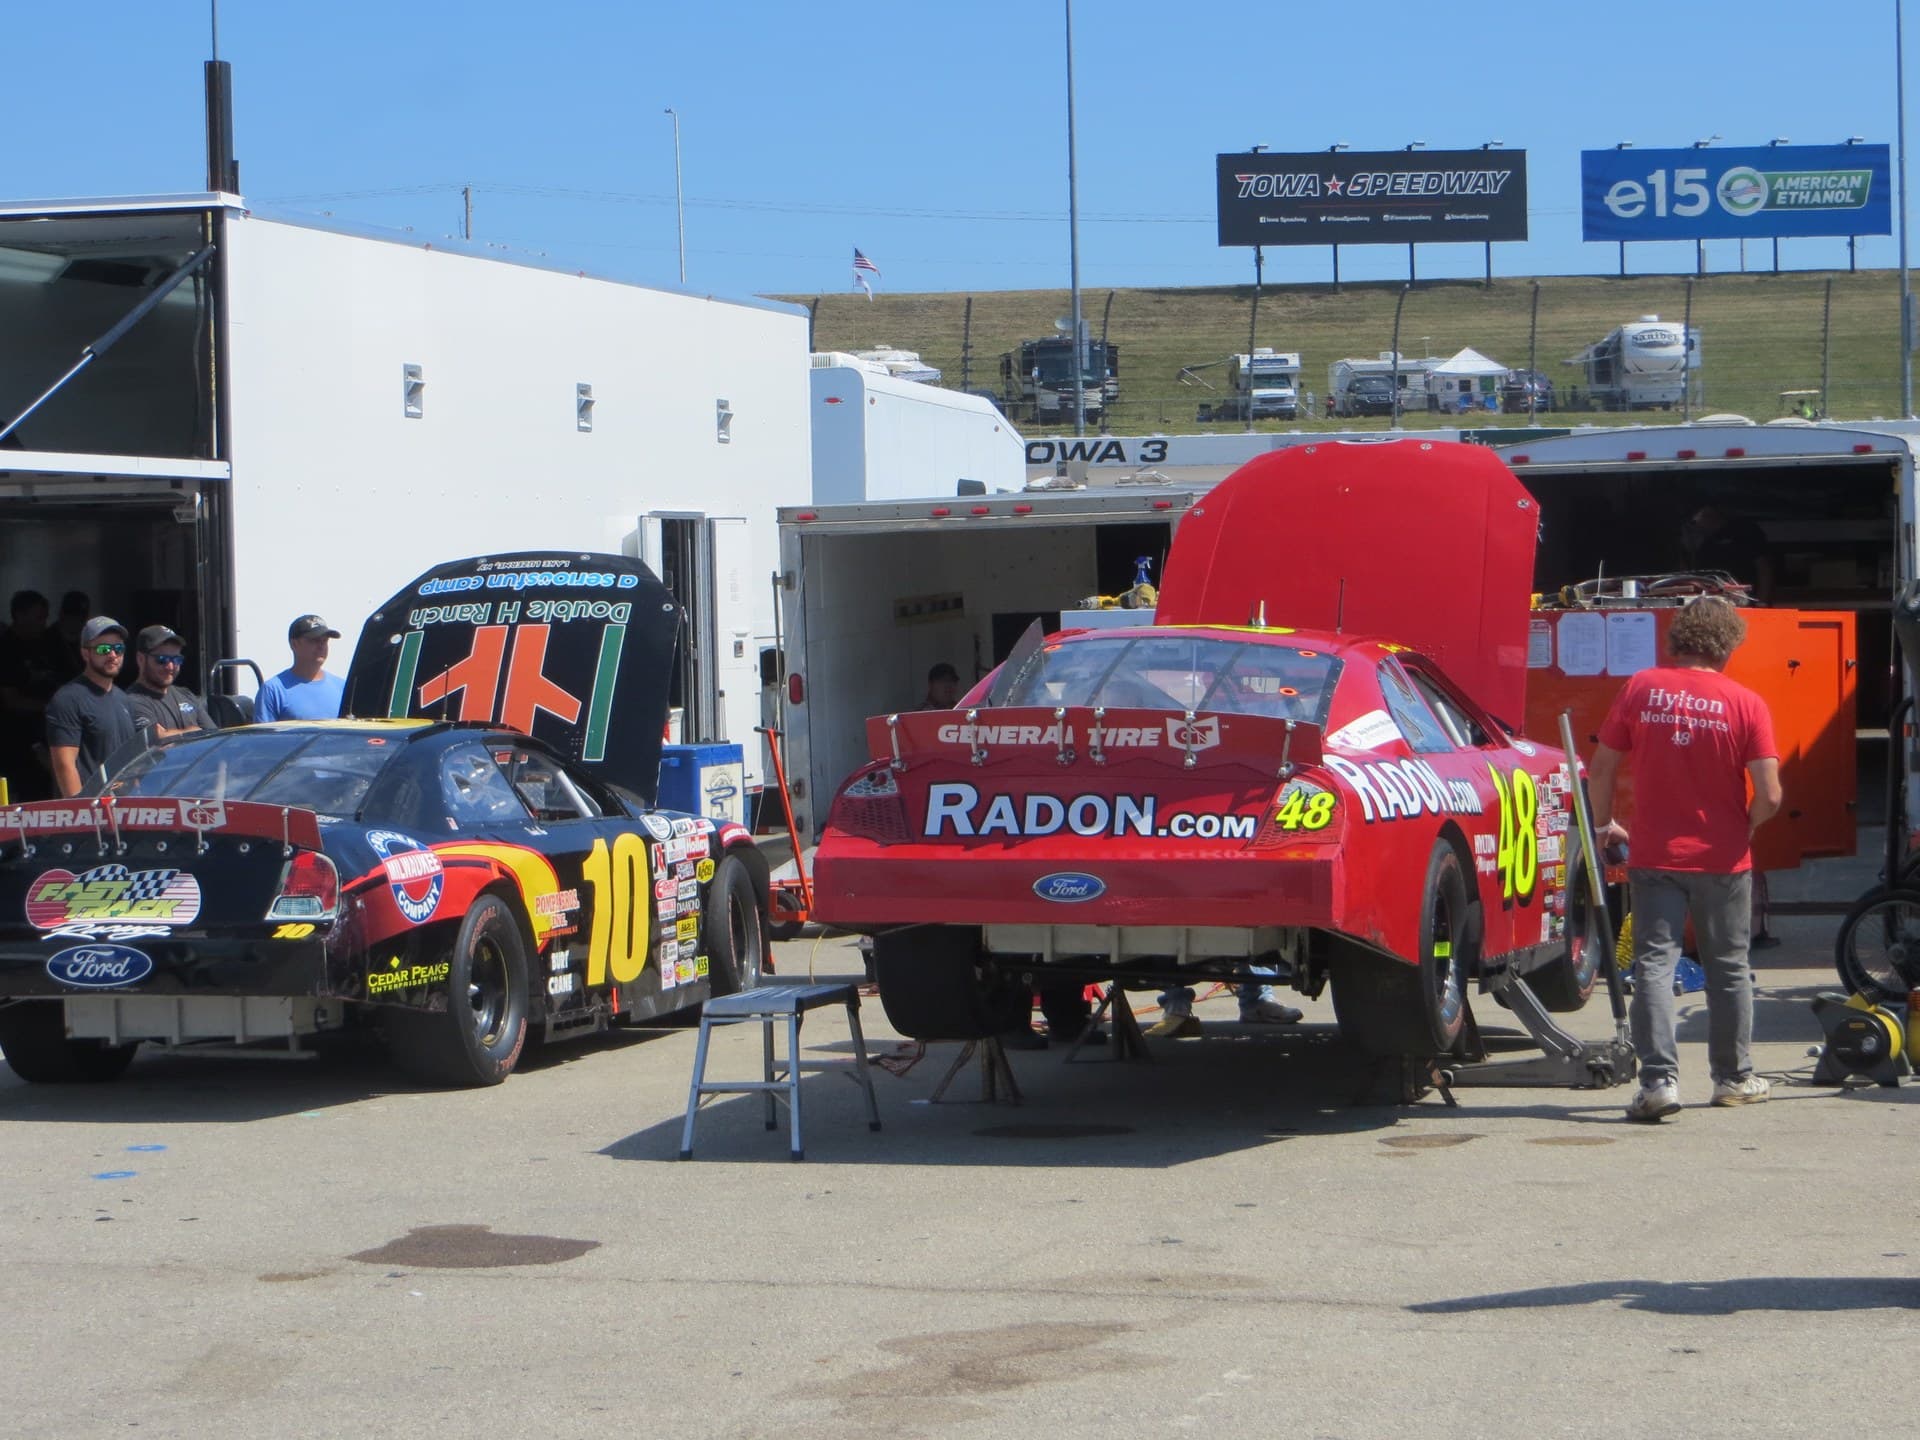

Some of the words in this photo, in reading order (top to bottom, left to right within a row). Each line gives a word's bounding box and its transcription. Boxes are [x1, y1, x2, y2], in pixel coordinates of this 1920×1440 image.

[1235, 174, 1320, 198] IOWA
[1347, 170, 1511, 196] SPEEDWAY
[1603, 168, 1710, 218] e15
[1772, 175, 1863, 191] AMERICAN
[1776, 190, 1856, 205] ETHANOL
[1024, 440, 1126, 464] OWA
[1139, 440, 1169, 463] 3
[418, 575, 485, 596] camp
[617, 574, 639, 589] a
[409, 603, 492, 629] Ranch
[497, 601, 521, 624] H
[526, 600, 632, 622] Double
[1648, 688, 1725, 714] Hylton
[1640, 711, 1729, 732] Motorsports
[1087, 728, 1162, 747] TIRE
[1671, 730, 1691, 746] 48
[0, 808, 108, 828] ENERAL
[113, 807, 176, 825] TIRE
[1275, 789, 1336, 830] 48
[1487, 761, 1538, 899] 48
[386, 852, 441, 881] MILWAUKEE
[34, 881, 134, 902] FAST
[1048, 878, 1089, 897] Ford
[64, 899, 184, 920] TRACK
[398, 881, 440, 919] COMPANY
[582, 832, 648, 986] 10
[272, 923, 315, 938] 10
[66, 949, 131, 978] Ford
[368, 970, 409, 988] CEDAR
[412, 962, 449, 980] PEAKS
[371, 978, 428, 994] ENTERPRISES
